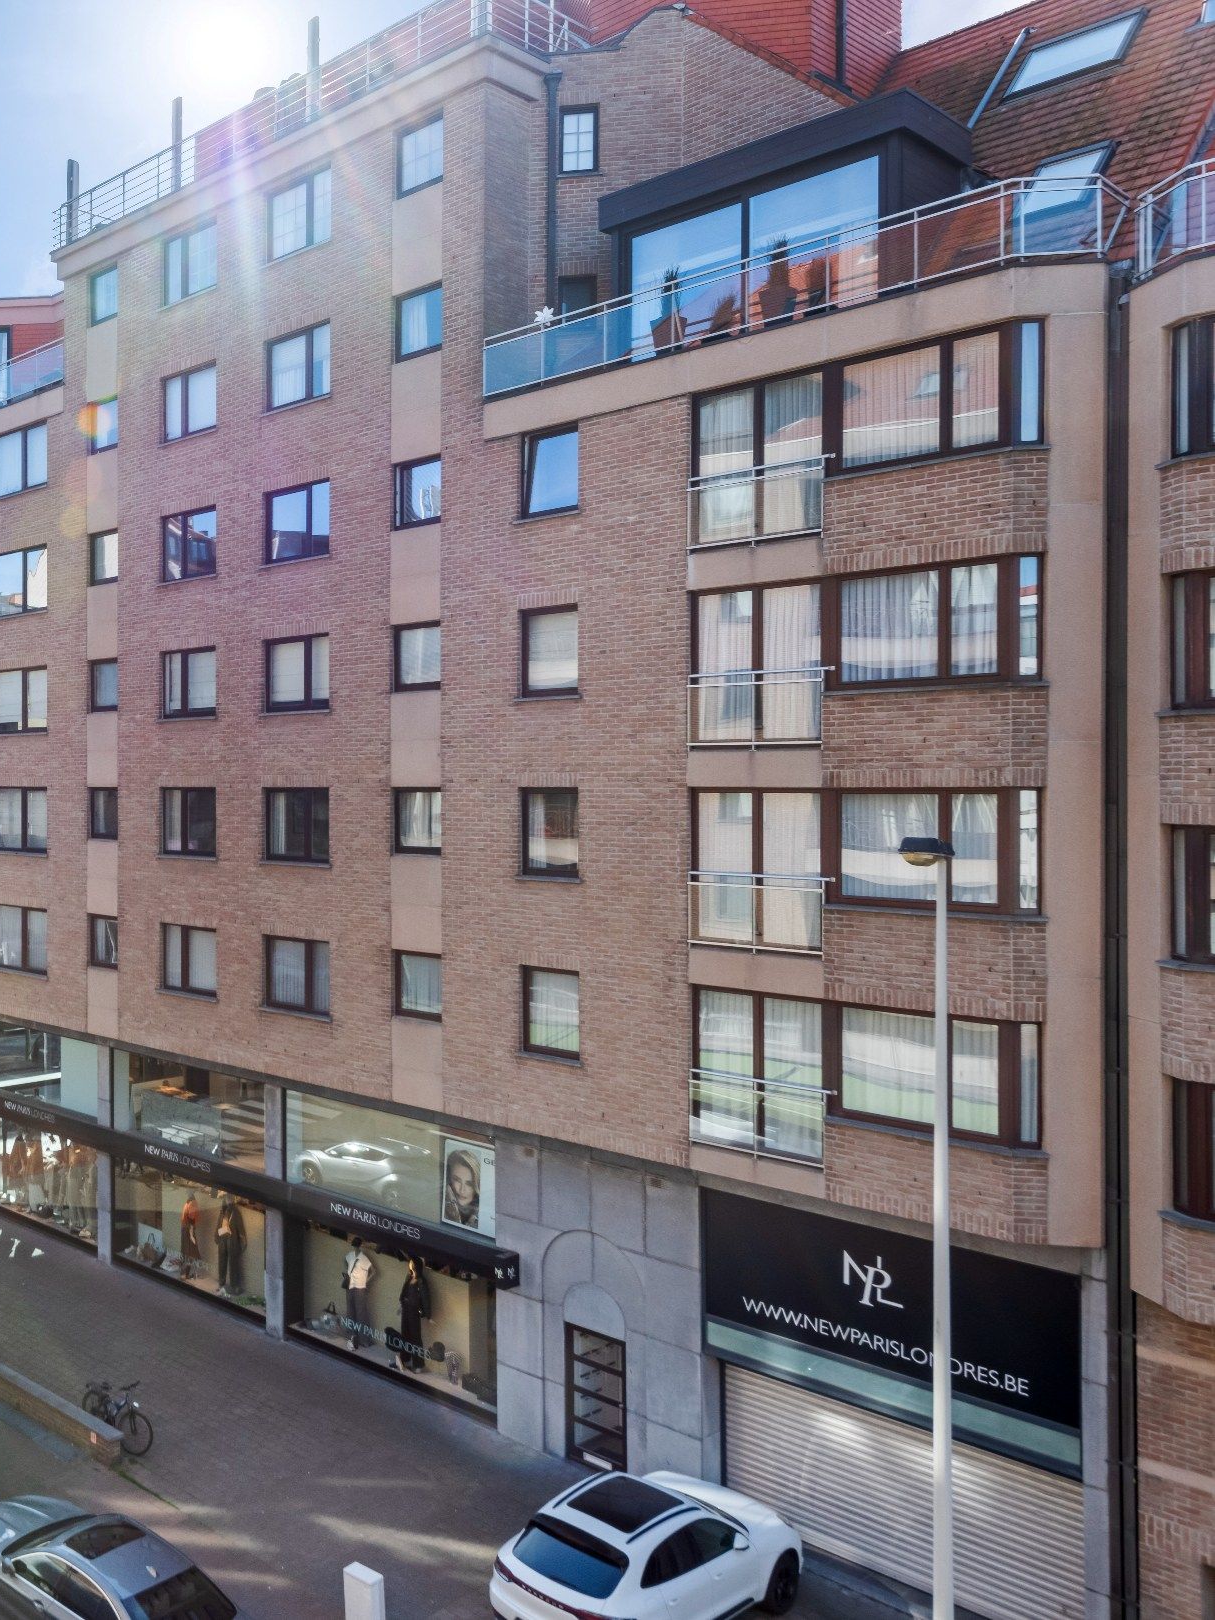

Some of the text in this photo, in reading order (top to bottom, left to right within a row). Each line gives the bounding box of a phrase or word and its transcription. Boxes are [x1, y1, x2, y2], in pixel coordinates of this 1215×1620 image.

[145, 1143, 211, 1173] NEW PARIS LONDRES
[330, 1202, 422, 1239] NEW PARIS LONDRES
[341, 1316, 362, 1332] NEW
